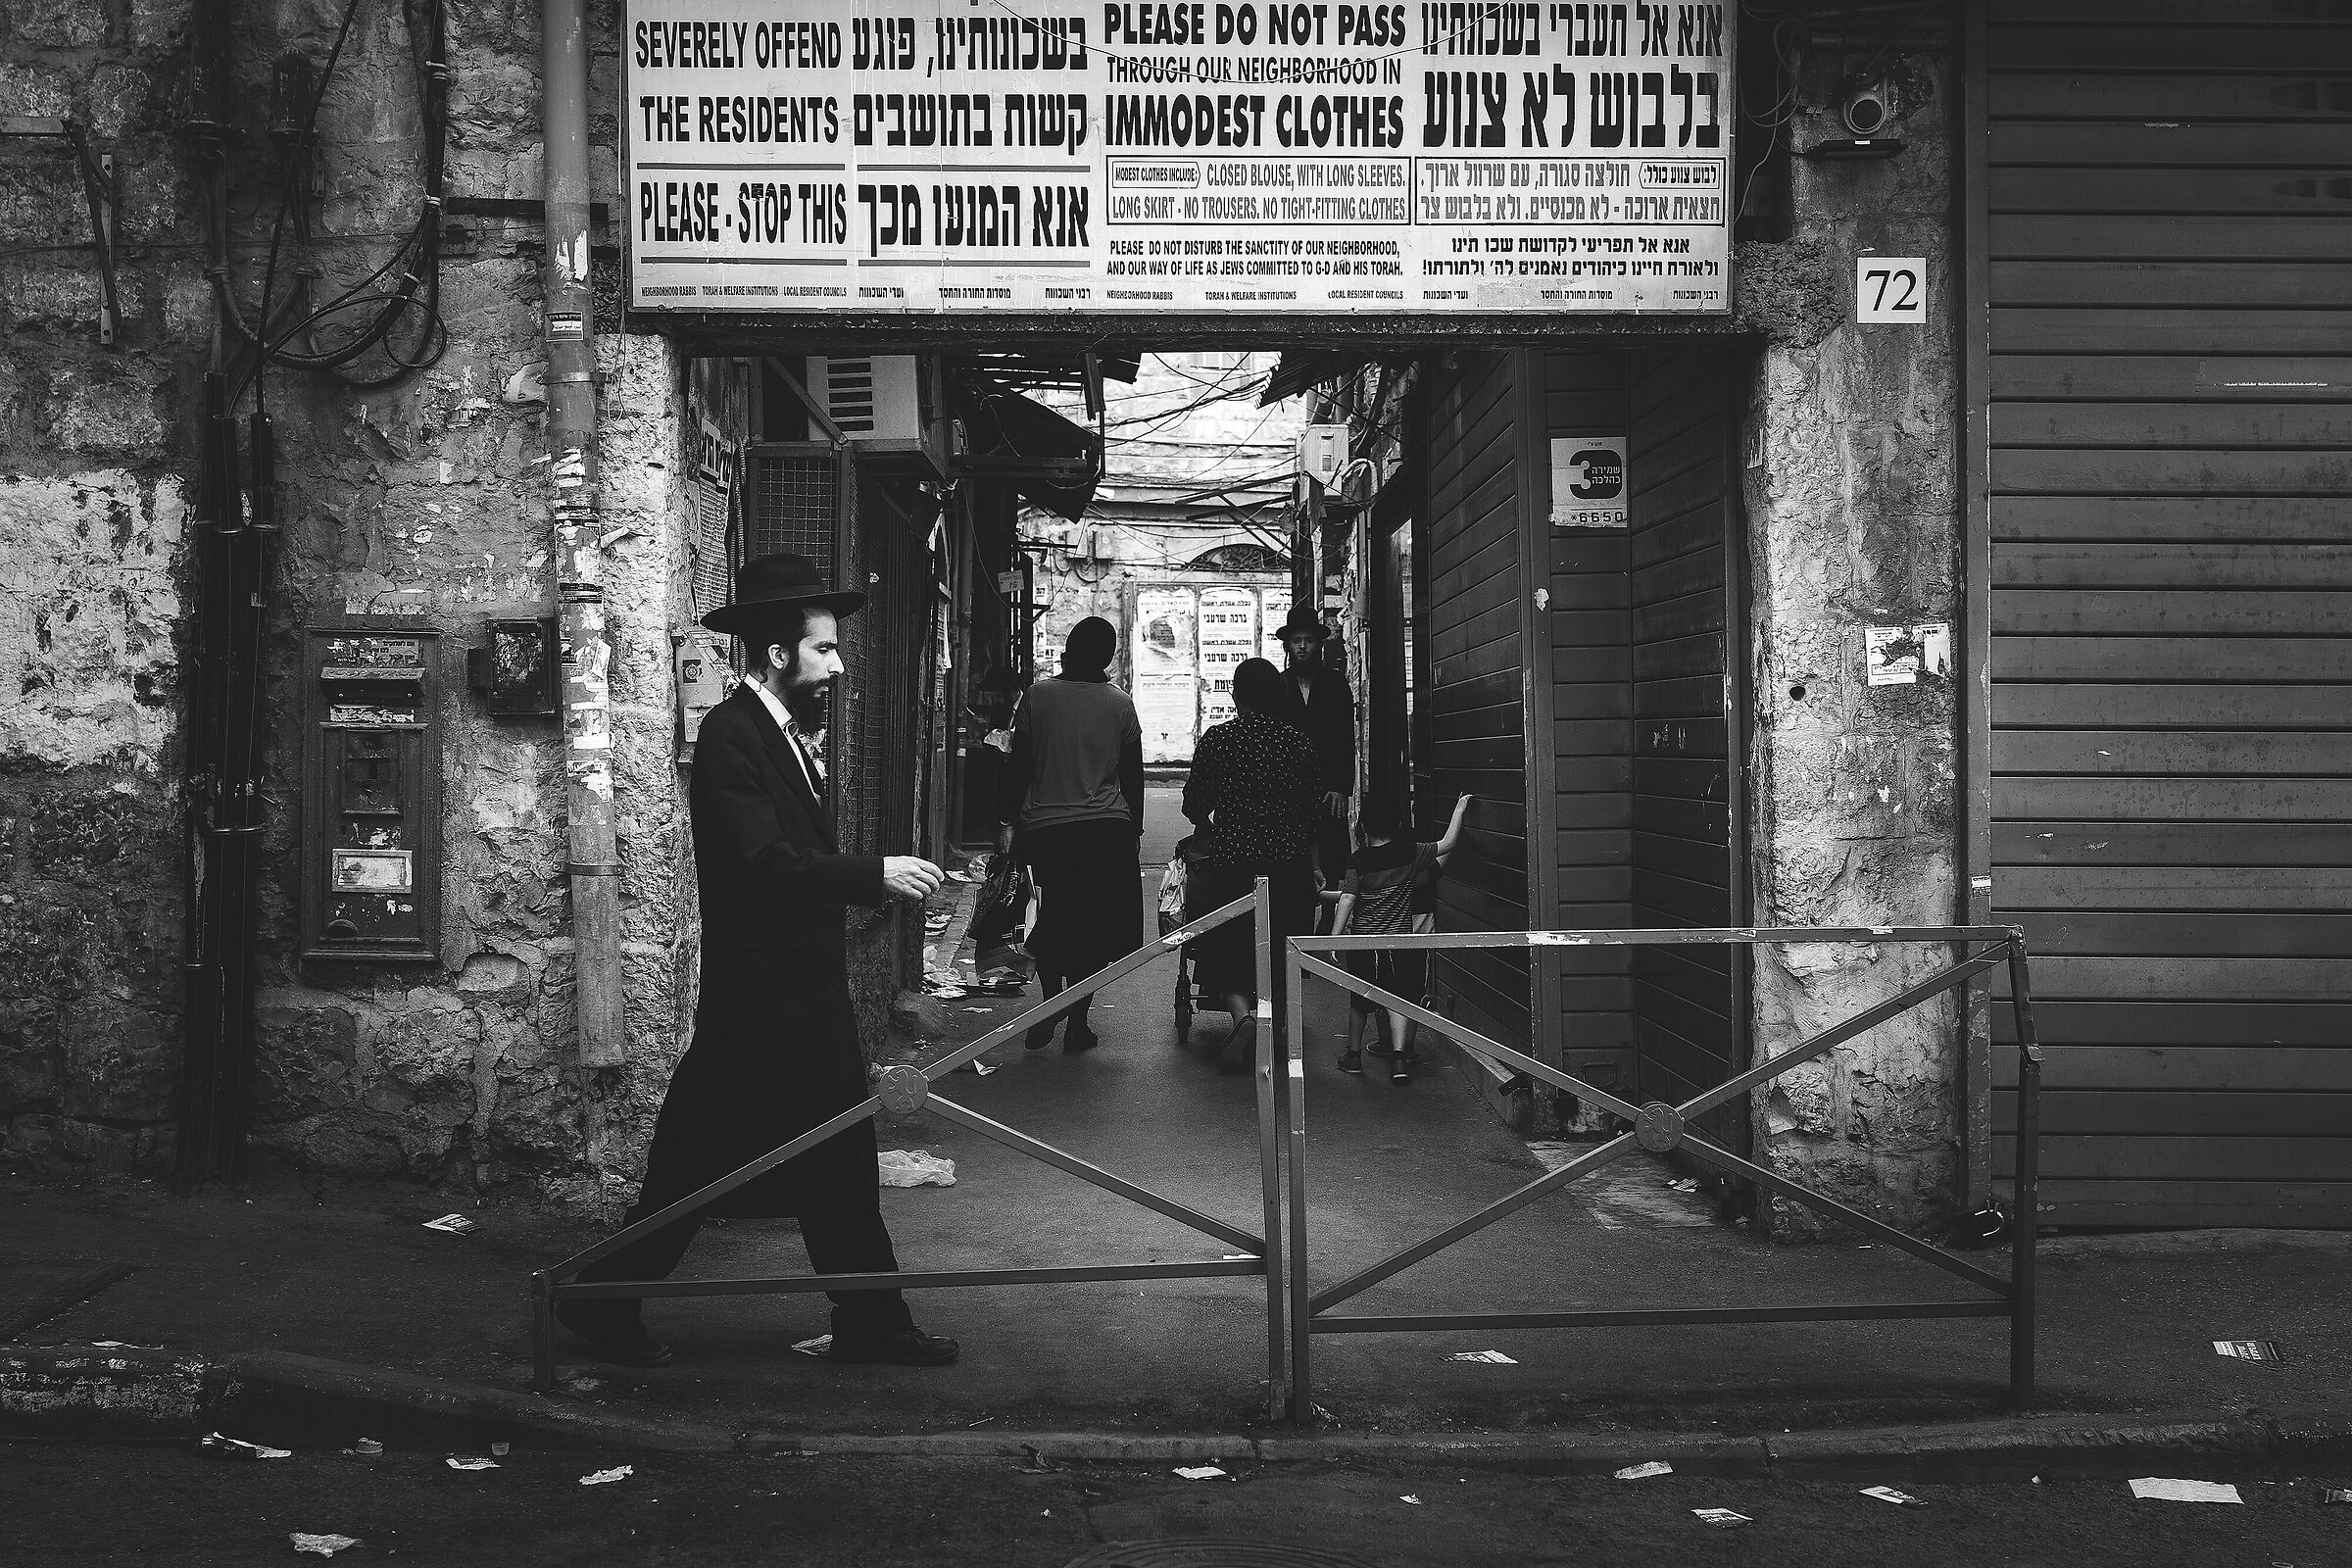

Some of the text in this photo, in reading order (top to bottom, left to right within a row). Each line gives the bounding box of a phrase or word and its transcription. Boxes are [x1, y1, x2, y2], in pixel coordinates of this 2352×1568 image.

[1104, 3, 1405, 46] PLEASE DO NOT PASS
[1550, 2, 1627, 56] תעברי
[1637, 0, 1670, 56] אל
[1676, 3, 1725, 58] אנא
[636, 21, 841, 69] SEVERELY OFFEND
[853, 16, 1087, 77] בשכונותינו, פוגע
[1107, 56, 1400, 84] THROUGH OUR NEIGHBORHOOD IN
[1423, 63, 1722, 150] בלבוש לא צנוע
[640, 96, 838, 143] THE RESIDENTS
[854, 94, 1087, 156] קשות בתושבים
[1106, 94, 1403, 148] IMMODEST CLOTHES
[1116, 168, 1139, 181] MODEST
[1142, 168, 1167, 181] CLOTHES
[1207, 164, 1404, 191] CLOSED BLOUSE, WITH LONG SLEEVES.
[1421, 159, 1630, 192] חולצה סגורה, עם שרוול ארוך.
[1671, 167, 1690, 183] צנוע
[1693, 166, 1716, 183] לבוש
[641, 181, 718, 242] PLEASE
[739, 182, 791, 243] STOP
[799, 183, 846, 244] THIS
[1113, 196, 1140, 219] LONG
[1145, 196, 1174, 219] SKIRT
[1185, 197, 1199, 219] NO
[1202, 197, 1259, 219] TROUSERS.
[1263, 197, 1277, 219] NO
[1281, 197, 1355, 220] TIGHT-FITTING
[1359, 197, 1404, 220] CLOTHES
[1421, 196, 1440, 219] צר
[1446, 194, 1491, 220] בלבוש
[1496, 194, 1520, 220] ולא
[1526, 197, 1585, 220] מכנסיים.
[1591, 194, 1609, 220] לא
[1625, 196, 1668, 220] ארוכה
[1672, 197, 1721, 222] חצאית
[858, 183, 1089, 257] אנא המנעו מכך
[1110, 240, 1399, 258] PLEASE DO NOT DISTURB THE SANCTITY OF OUR NEIGHBORHOOD,
[1519, 237, 1576, 256] לקדושת
[1582, 238, 1633, 252] תפריעי
[1639, 237, 1657, 253] אל
[1663, 239, 1690, 253] אנא
[1107, 261, 1402, 275] AND OUR WAY OF LIFE AS JEWS COMMITTED TO G-D AND HIS TORAH.
[1519, 261, 1567, 275] נאמנים
[1573, 262, 1626, 275] כיהודים
[1632, 262, 1662, 275] חיינו
[1668, 260, 1718, 275] ולאורח
[1258, 291, 1297, 300] INSTITUTIONS
[1866, 270, 1918, 311] 72
[1592, 466, 1620, 474] שמירה
[1592, 474, 1620, 484] כהלכה
